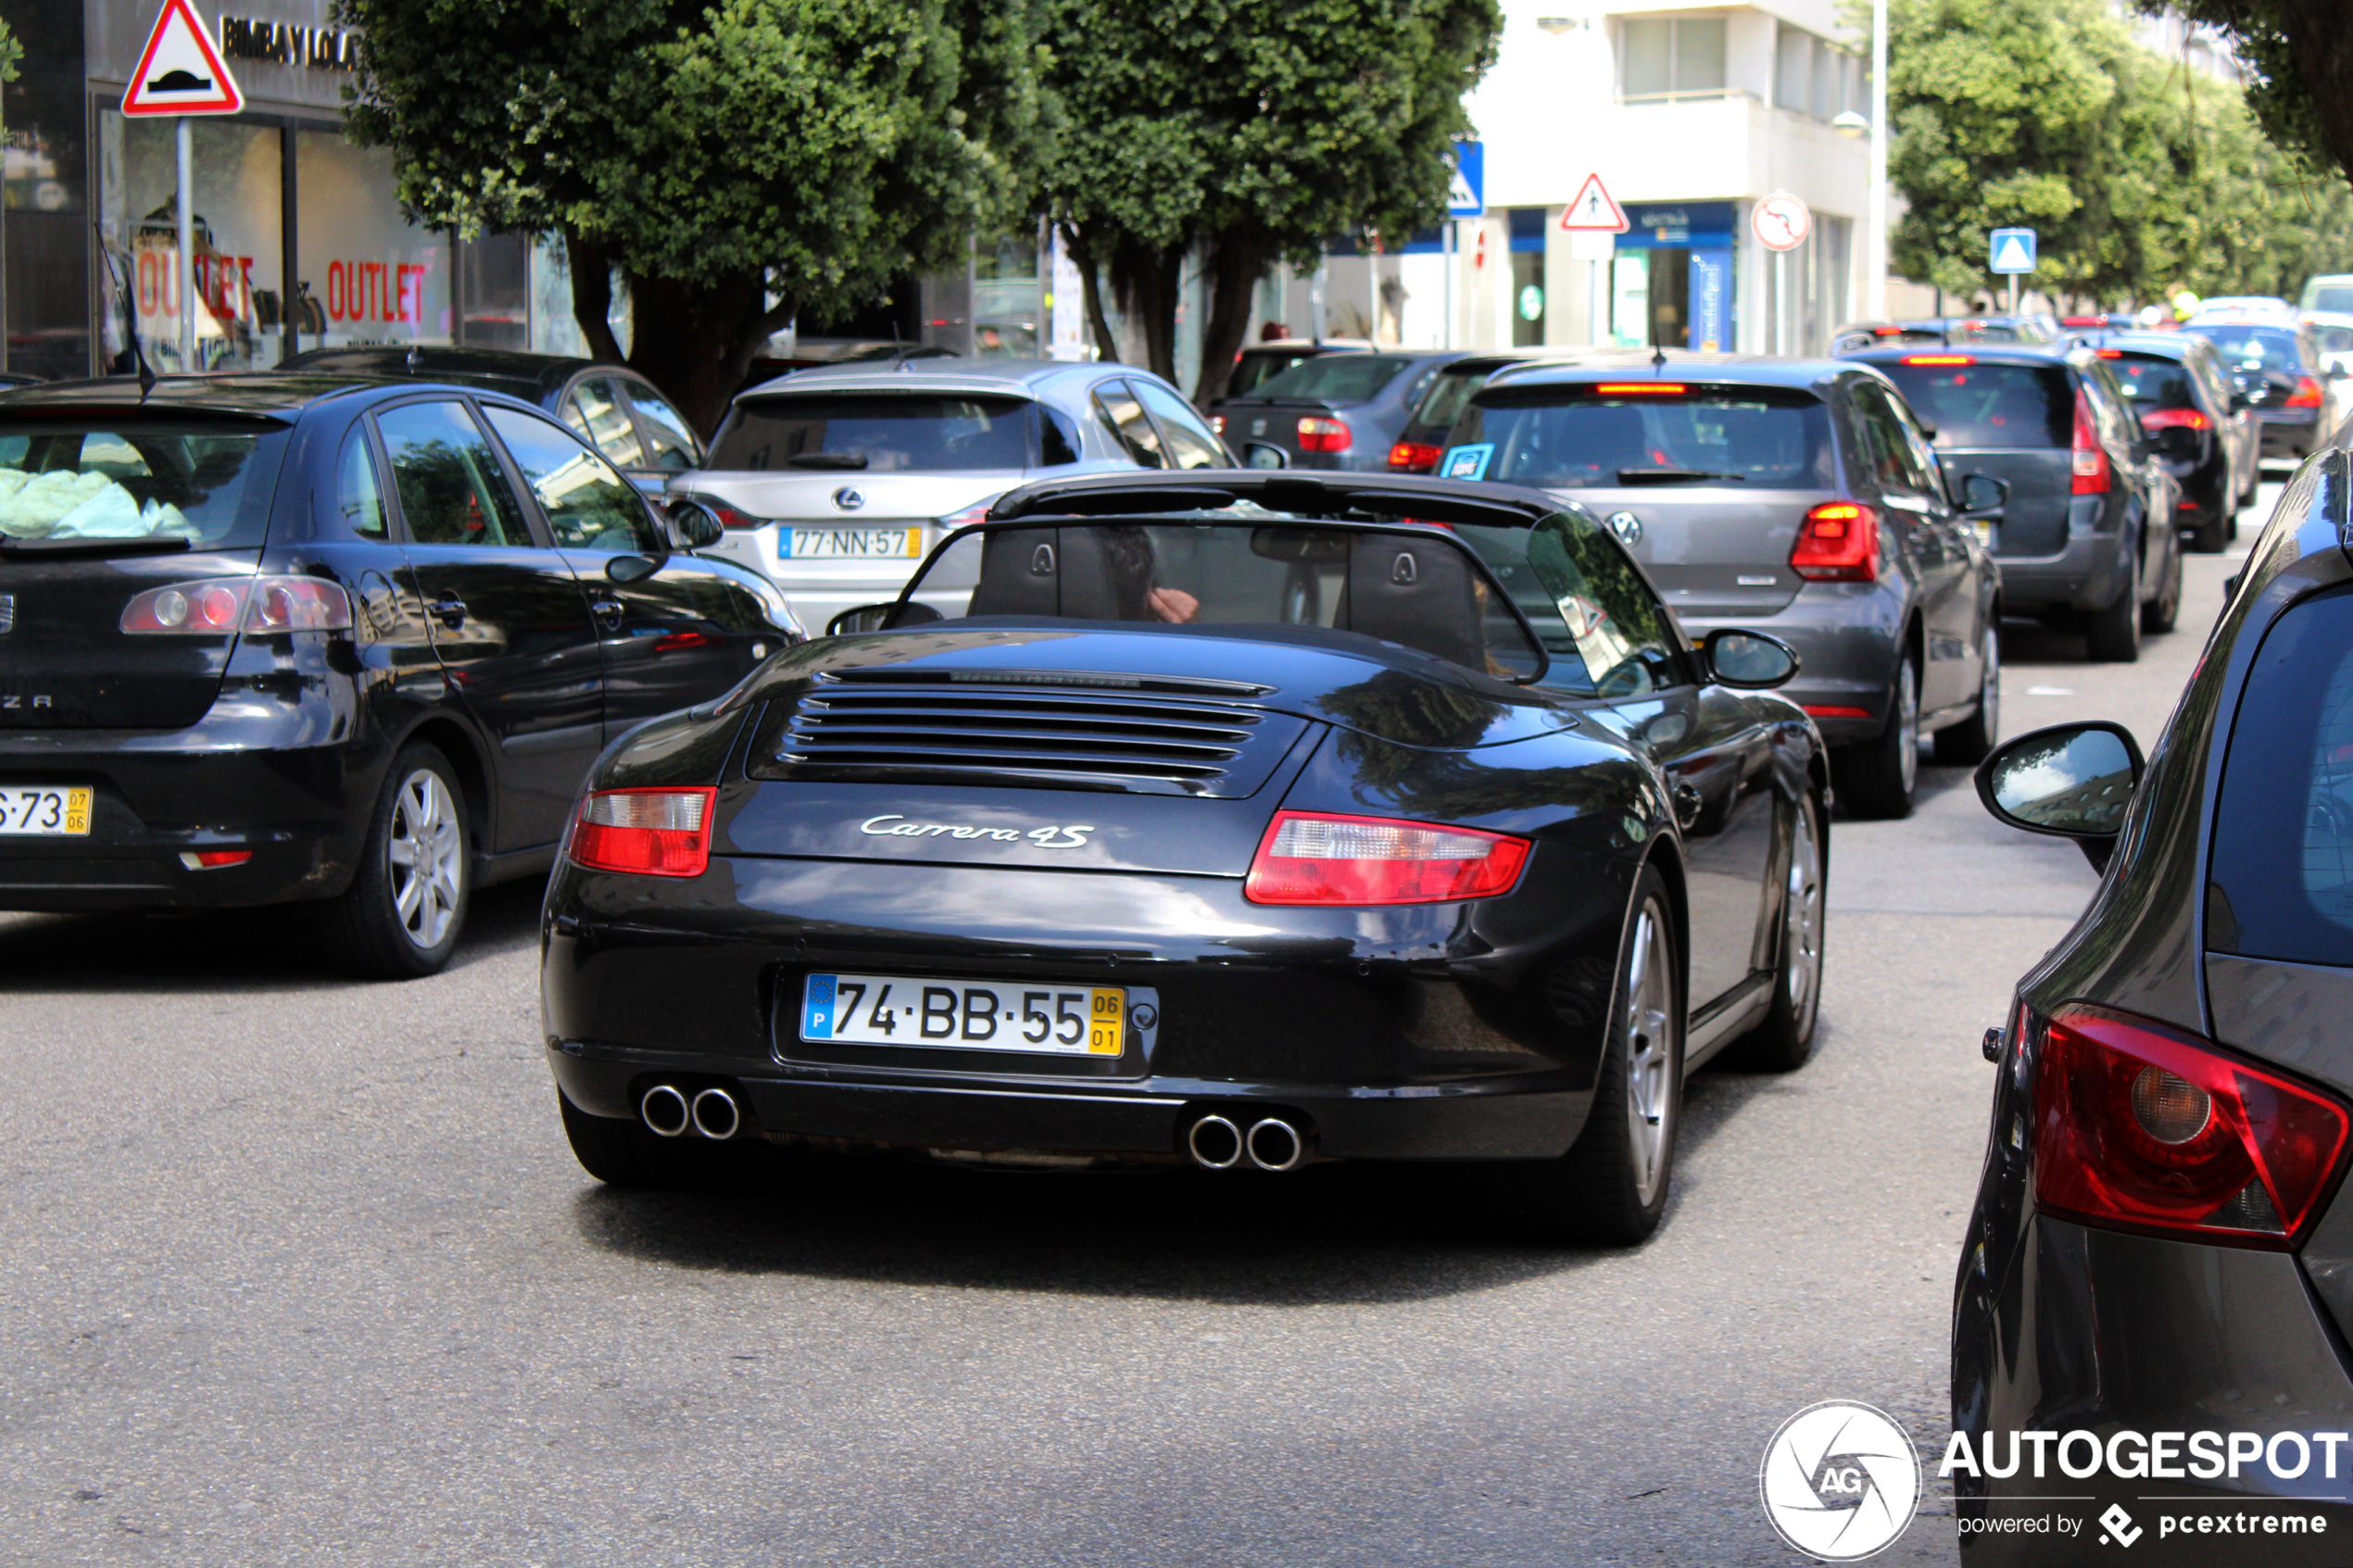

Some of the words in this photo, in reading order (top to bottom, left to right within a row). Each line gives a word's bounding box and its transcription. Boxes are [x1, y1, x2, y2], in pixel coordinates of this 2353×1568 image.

[220, 15, 285, 64] BIMBA
[285, 25, 302, 66] Y
[303, 27, 359, 71] LOLA
[328, 260, 425, 322] OUTLET
[69, 794, 86, 806] 07
[69, 816, 84, 829] 06
[861, 815, 1020, 842] Carrera
[1027, 825, 1095, 848] 4S
[1094, 995, 1118, 1014] 06
[813, 1013, 825, 1028] P
[1092, 1029, 1114, 1047] 01
